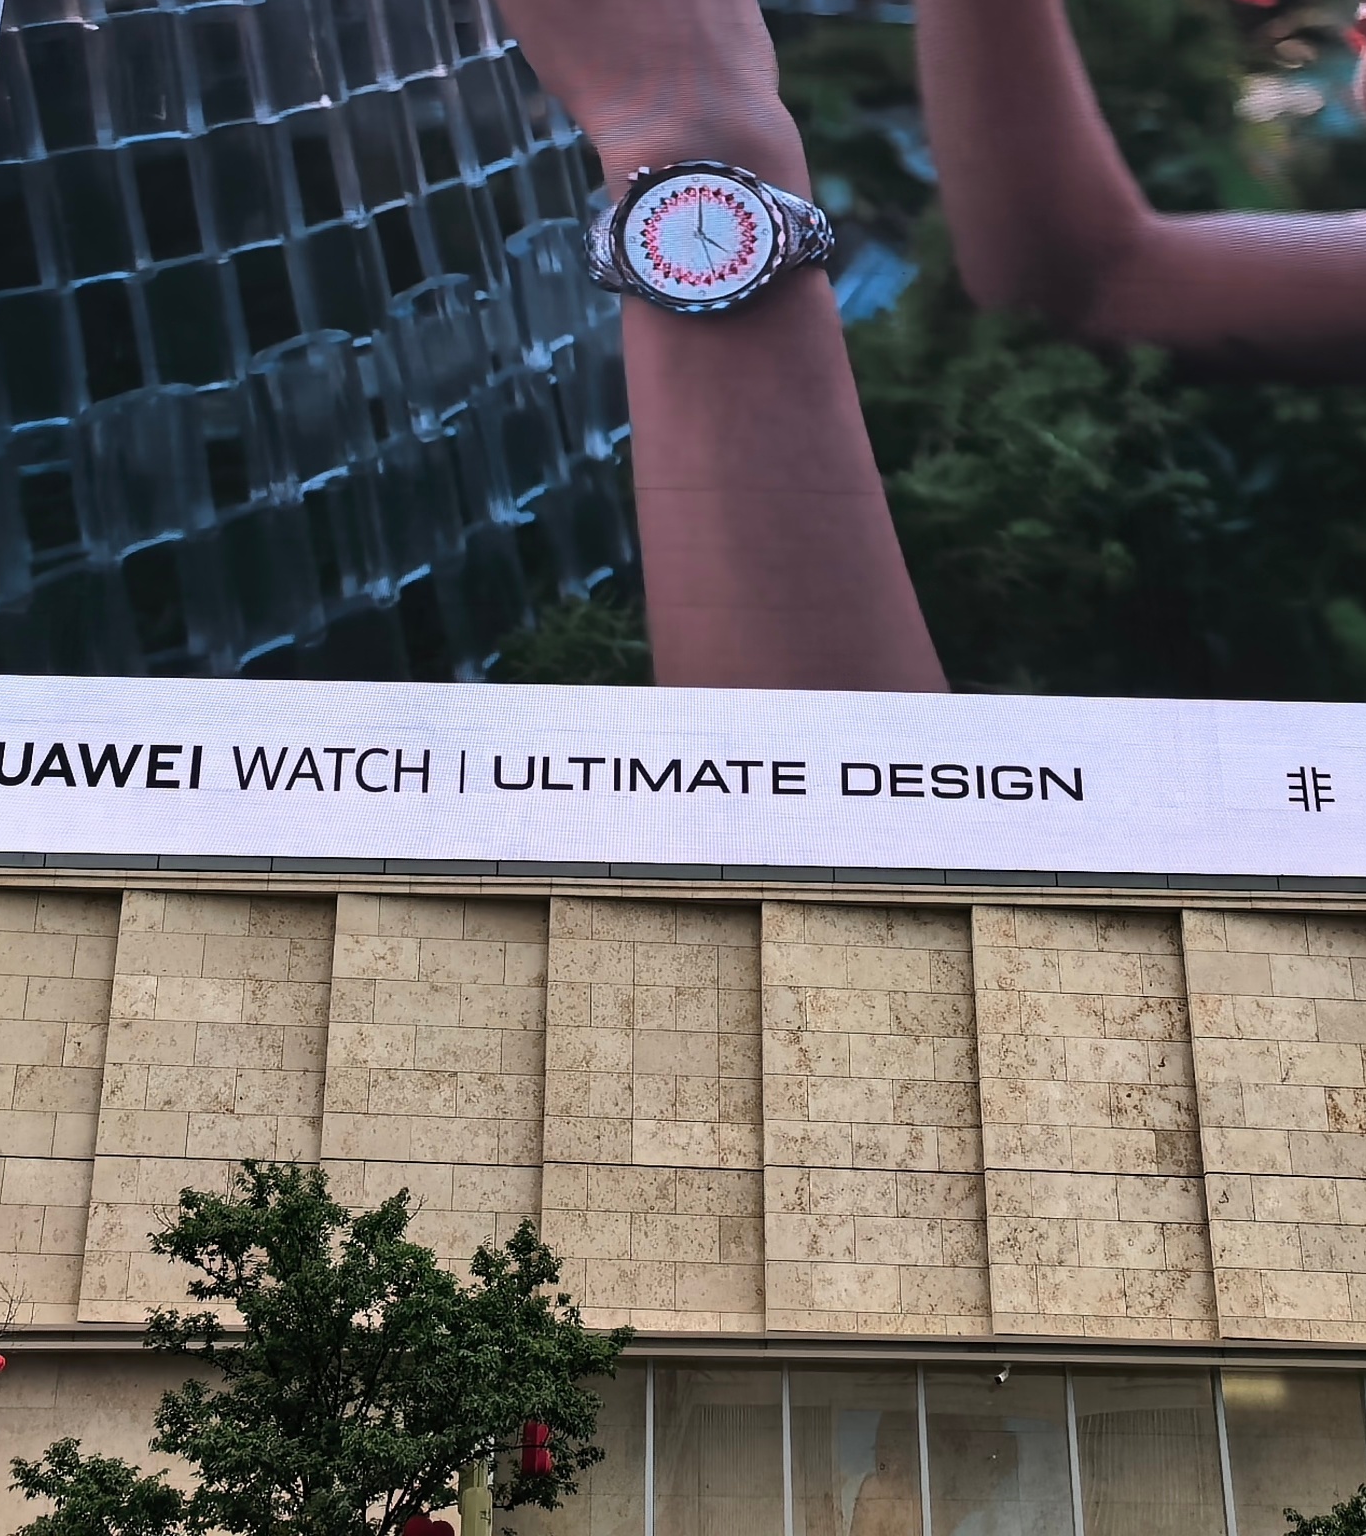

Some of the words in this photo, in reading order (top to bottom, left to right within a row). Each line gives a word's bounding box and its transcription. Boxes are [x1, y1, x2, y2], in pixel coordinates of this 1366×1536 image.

[232, 745, 430, 794] WATCH
[493, 755, 807, 796] ULTIMATE
[840, 762, 1084, 802] DESIGN
